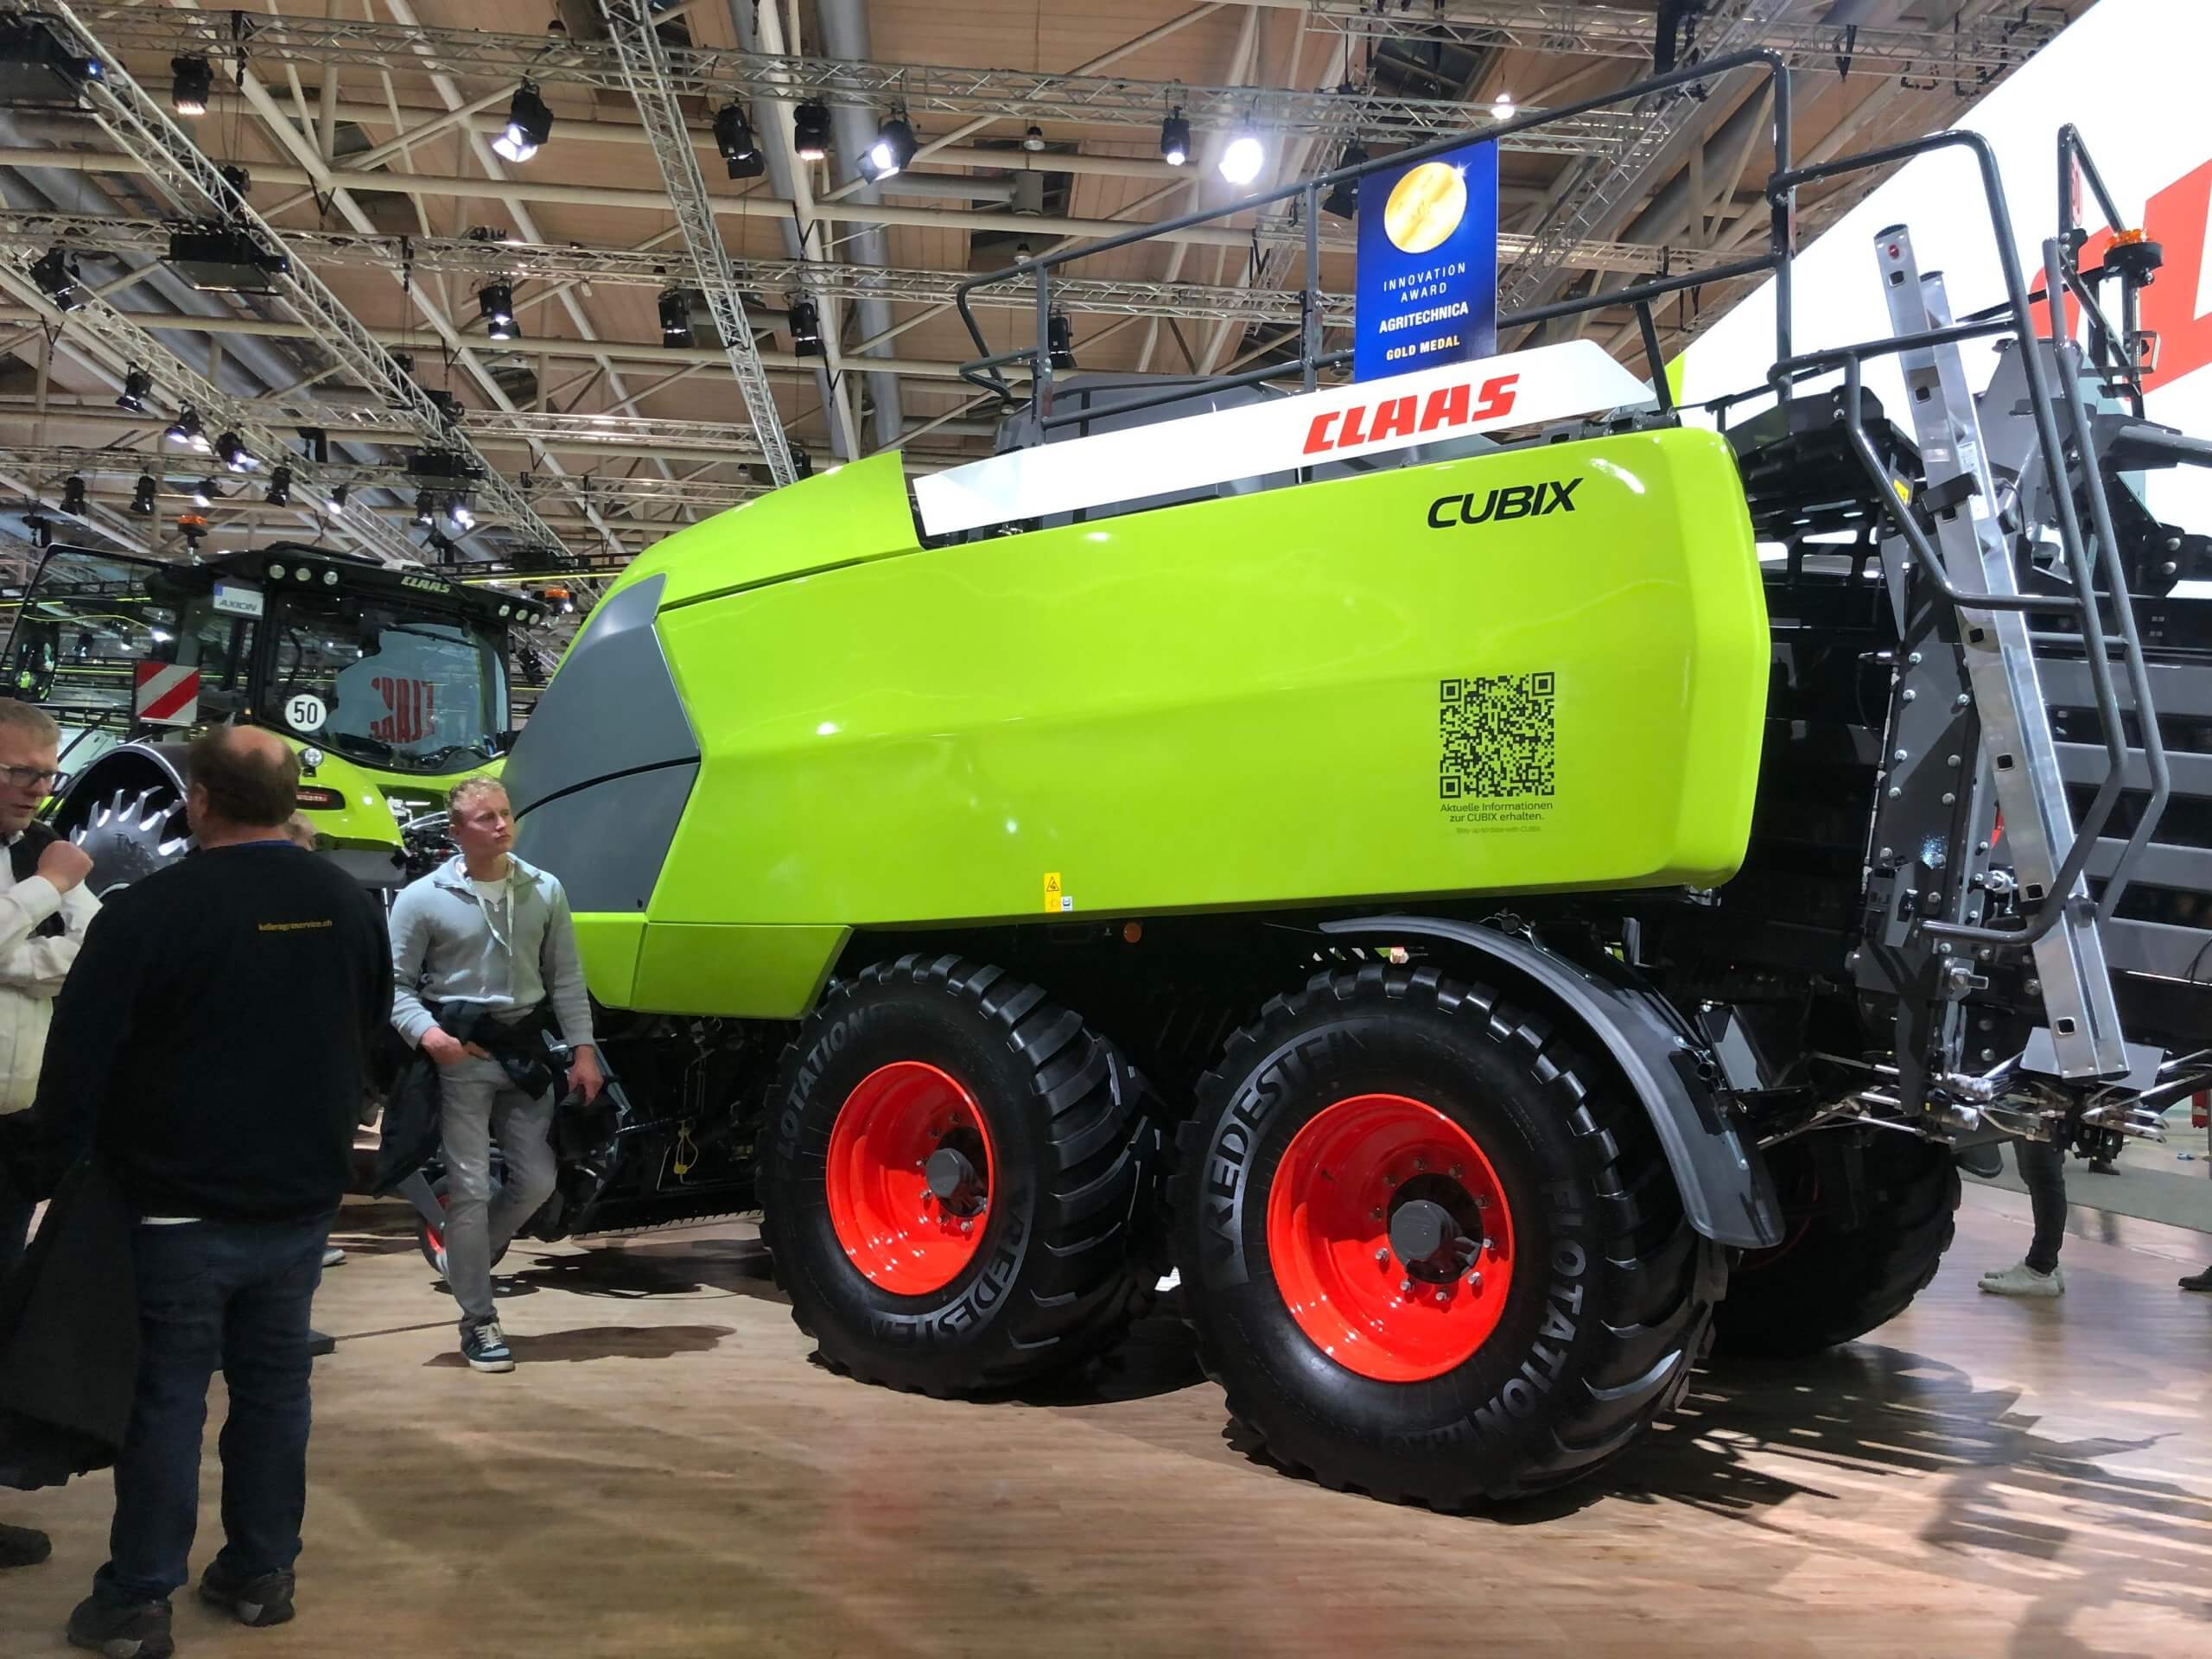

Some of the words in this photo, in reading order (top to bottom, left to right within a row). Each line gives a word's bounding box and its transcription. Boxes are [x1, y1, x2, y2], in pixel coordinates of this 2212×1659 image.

[1383, 263, 1466, 292] INNOVATION
[1401, 283, 1447, 302] AWARD
[1378, 302, 1469, 334] AGRITECHNICA
[1386, 344, 1416, 360] GOLD
[1420, 334, 1460, 353] MEDAL
[1302, 373, 1520, 455] CLAAS
[1427, 478, 1584, 529] CUBIX
[400, 575, 451, 594] CLAAS
[294, 701, 318, 724] 50
[1440, 804, 1480, 812] Aktuelle
[1482, 801, 1553, 811] Informationen
[1450, 814, 1465, 823] zur
[1467, 812, 1497, 822] CUBIX
[1500, 811, 1545, 822] erhalten.
